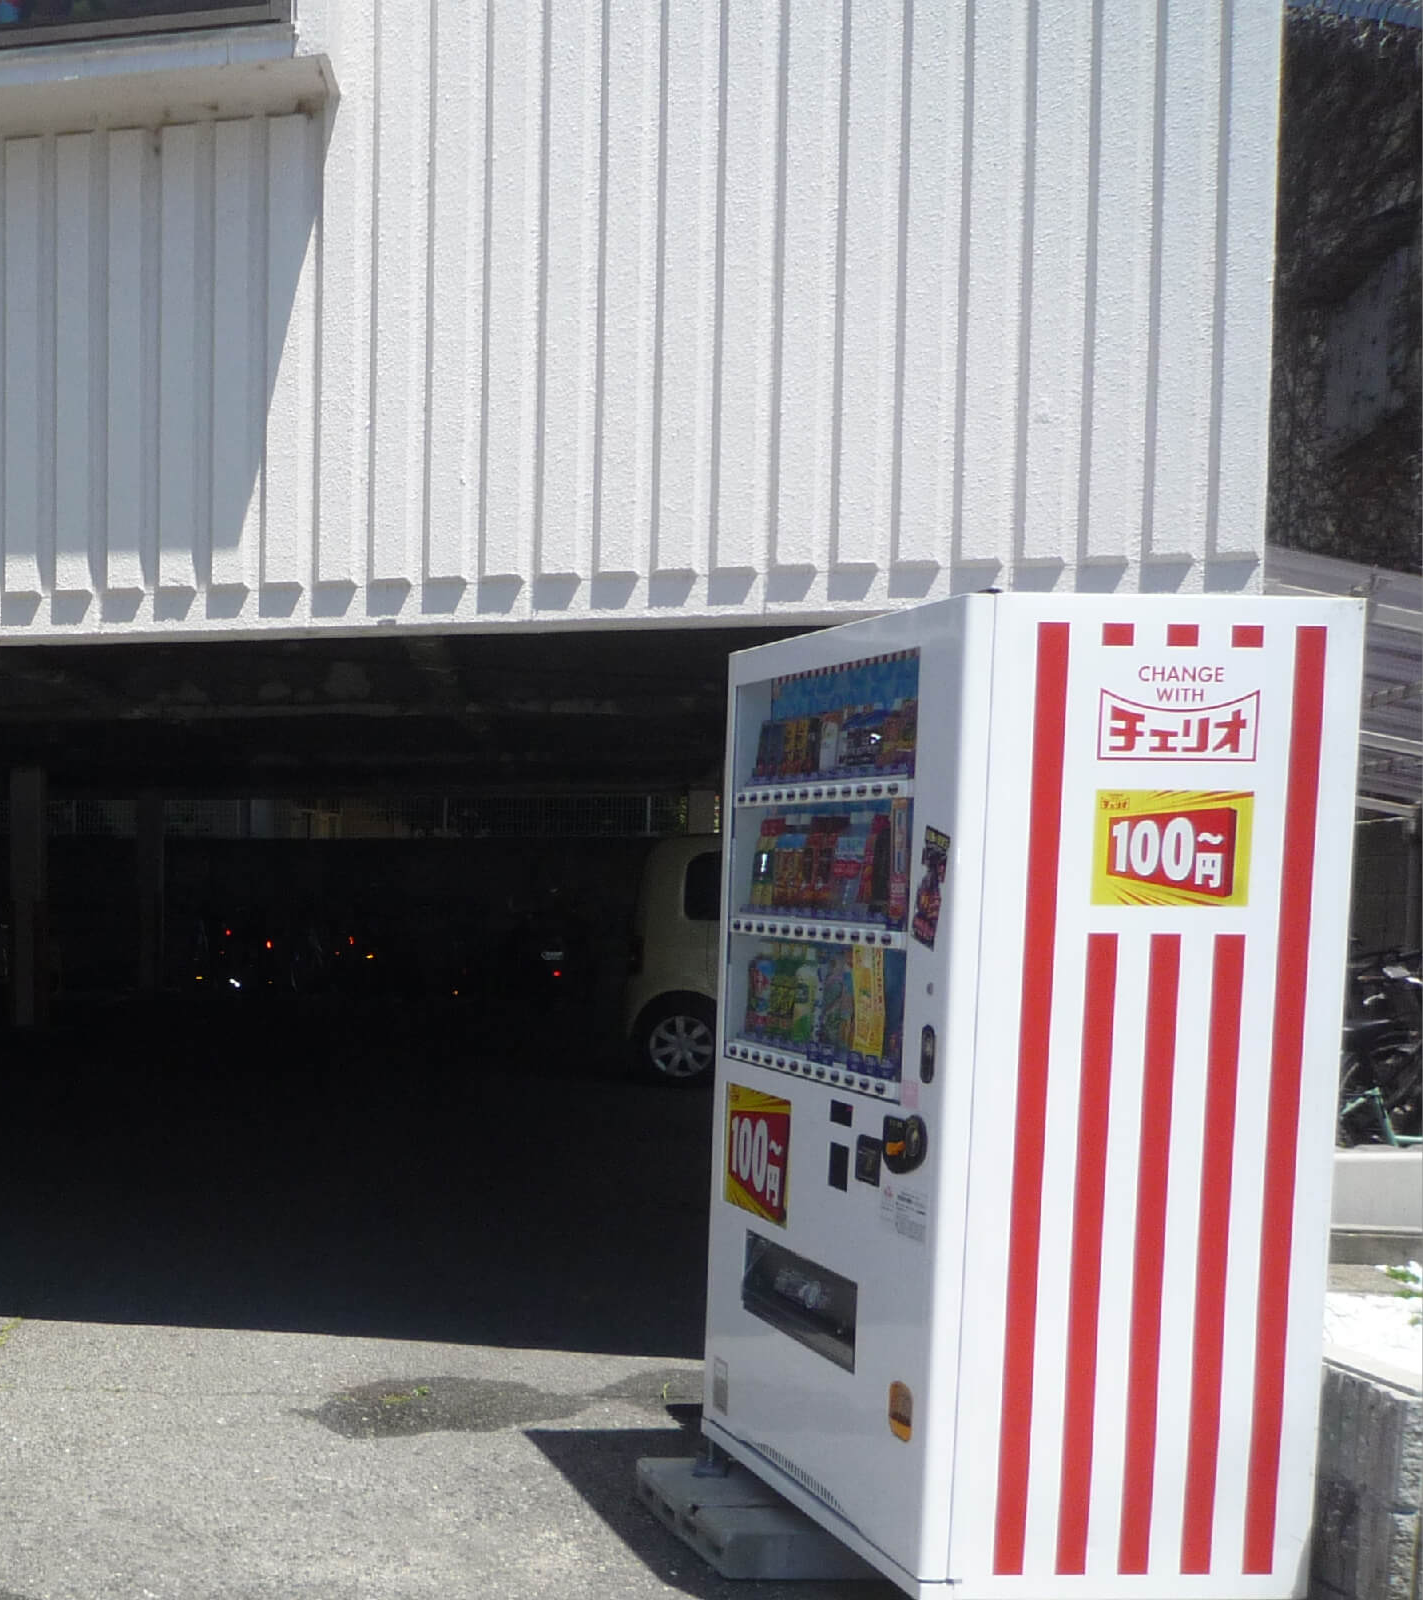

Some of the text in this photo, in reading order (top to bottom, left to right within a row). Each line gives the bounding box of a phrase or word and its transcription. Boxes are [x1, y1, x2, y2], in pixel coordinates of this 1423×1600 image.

[1138, 666, 1225, 682] CHANGE
[1156, 687, 1205, 702] WITH
[1109, 705, 1247, 753] チェリオ
